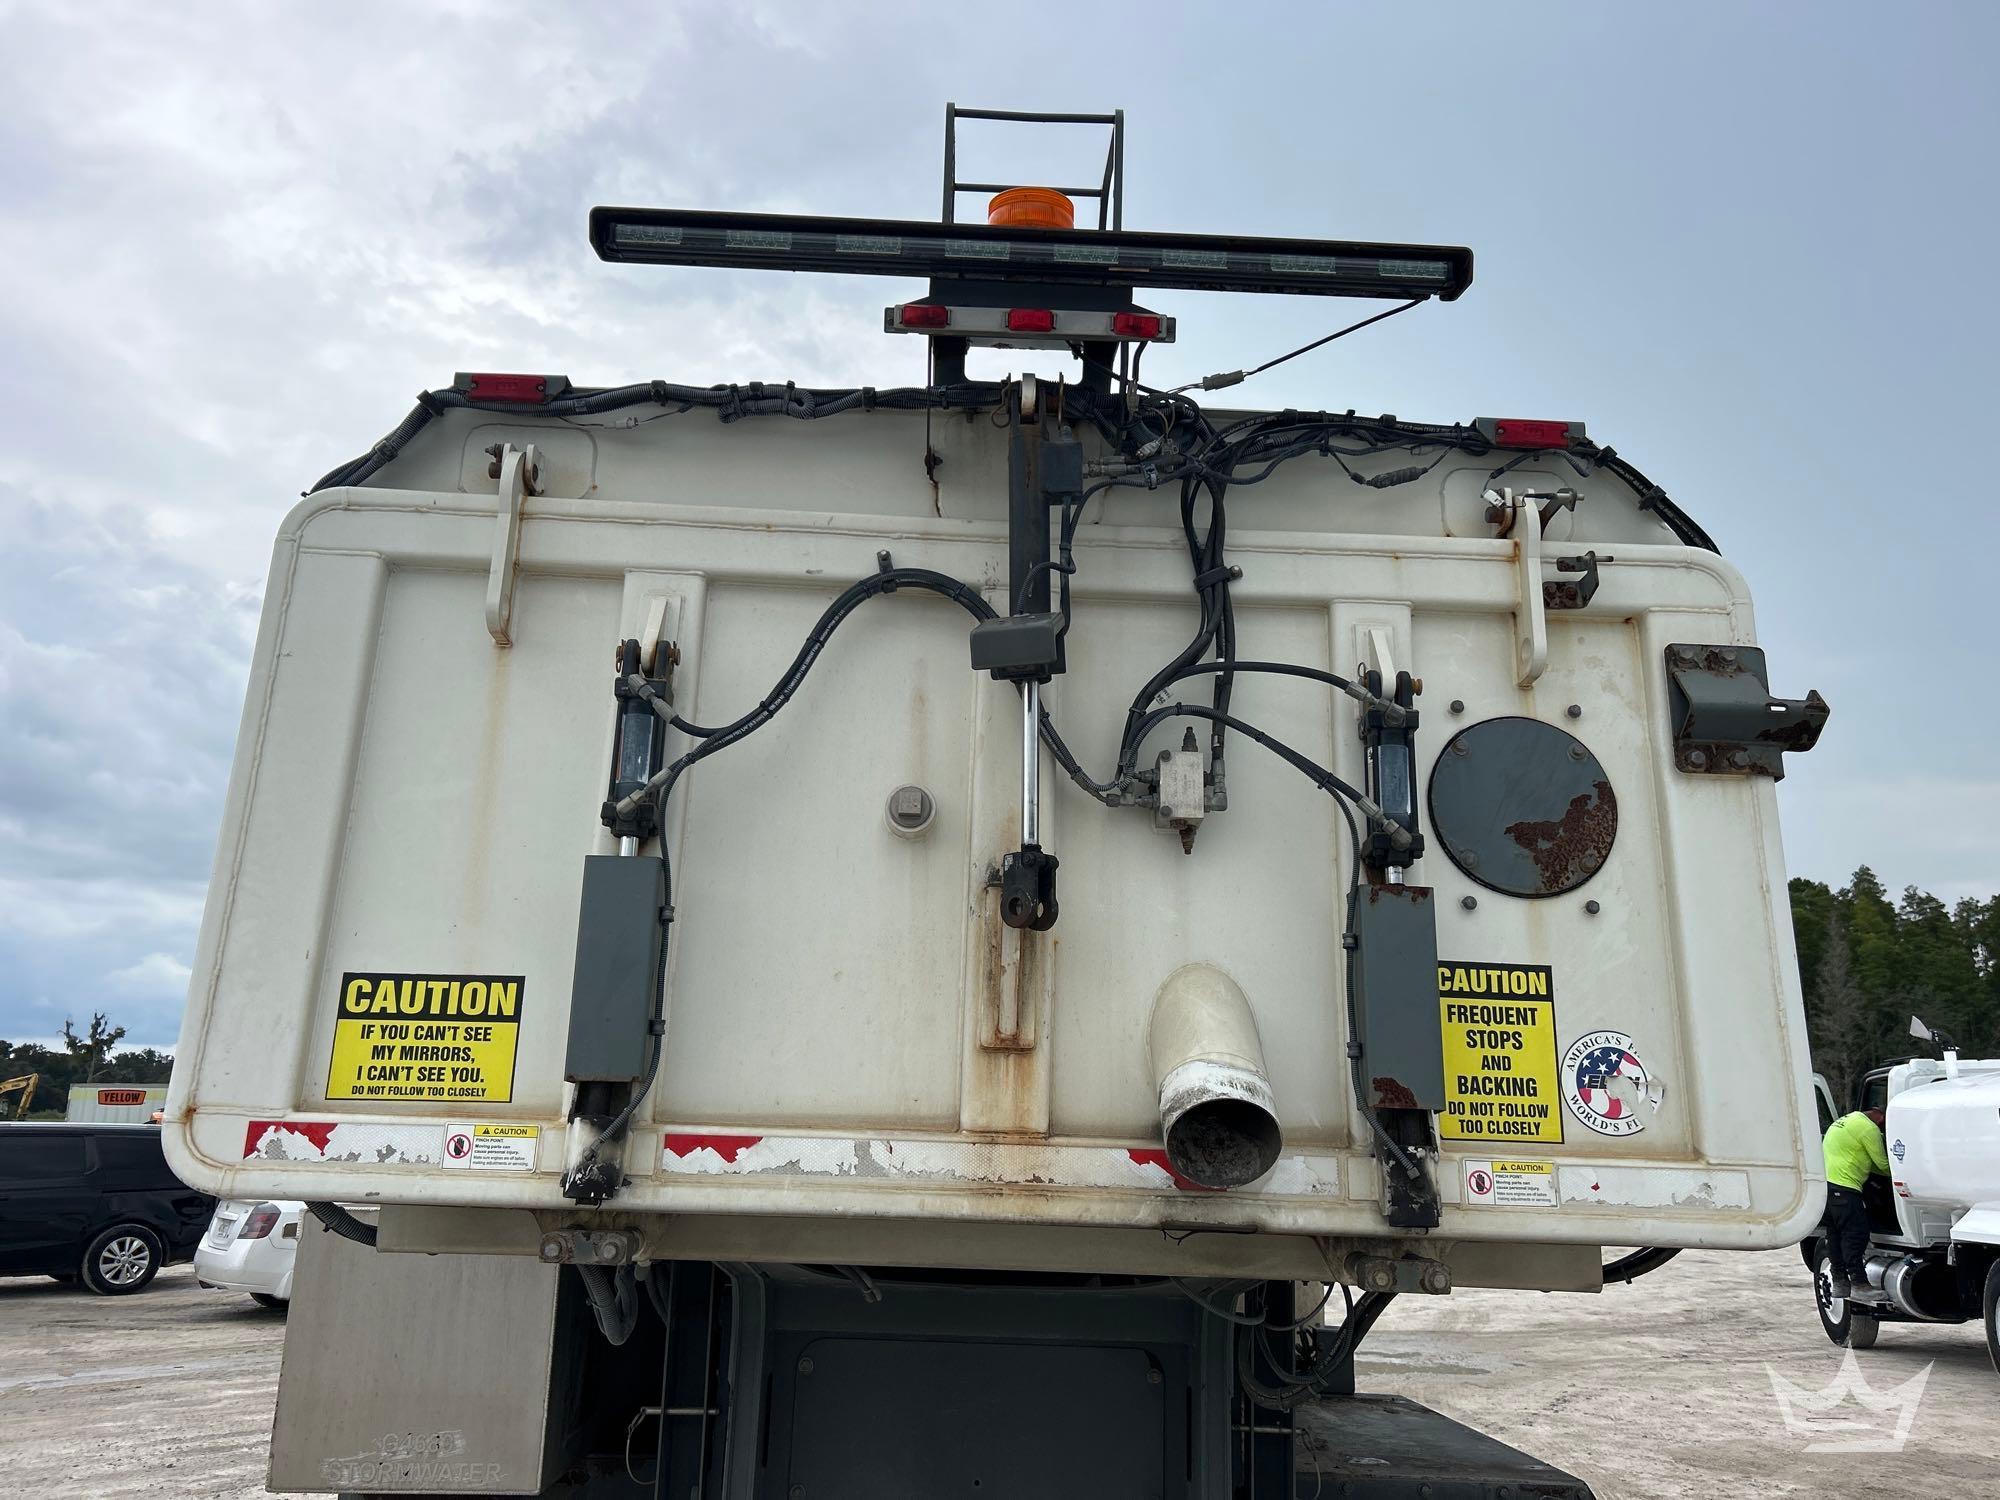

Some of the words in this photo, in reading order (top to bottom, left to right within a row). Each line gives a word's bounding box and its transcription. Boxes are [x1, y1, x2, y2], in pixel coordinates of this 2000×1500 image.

[1438, 968, 1546, 995] CAUTION
[346, 979, 517, 1016] CAUTION
[1447, 1004, 1537, 1026] FREQUENT
[361, 1024, 375, 1039] IF
[380, 1025, 409, 1040] YOU
[414, 1026, 460, 1041] CAN'T
[464, 1027, 492, 1041] SEE
[1466, 1030, 1523, 1050] STOPS
[371, 1045, 396, 1060] MY
[400, 1046, 475, 1064] MIRRORS,
[1481, 1055, 1511, 1071] AND
[1566, 1036, 1622, 1072] AMERICA'S
[357, 1066, 362, 1080] I
[367, 1066, 413, 1081] CAN'T
[417, 1067, 446, 1082] SEE
[451, 1068, 484, 1082] YOU.
[352, 1086, 364, 1095] DO
[367, 1086, 386, 1095] NOT
[388, 1086, 425, 1096] FOLLOW
[428, 1087, 444, 1096] TOO
[448, 1087, 486, 1097] CLOSELY
[1457, 1075, 1537, 1097] BACKING
[104, 1093, 140, 1102] YELLOW
[1448, 1101, 1465, 1115] DO
[1470, 1102, 1494, 1116] NOT
[1499, 1103, 1548, 1118] FOLLOW
[1570, 1095, 1620, 1132] WORLD'S
[1459, 1120, 1483, 1133] TOO
[1487, 1121, 1540, 1135] CLOSELY
[327, 1461, 501, 1482] STORMWATER
